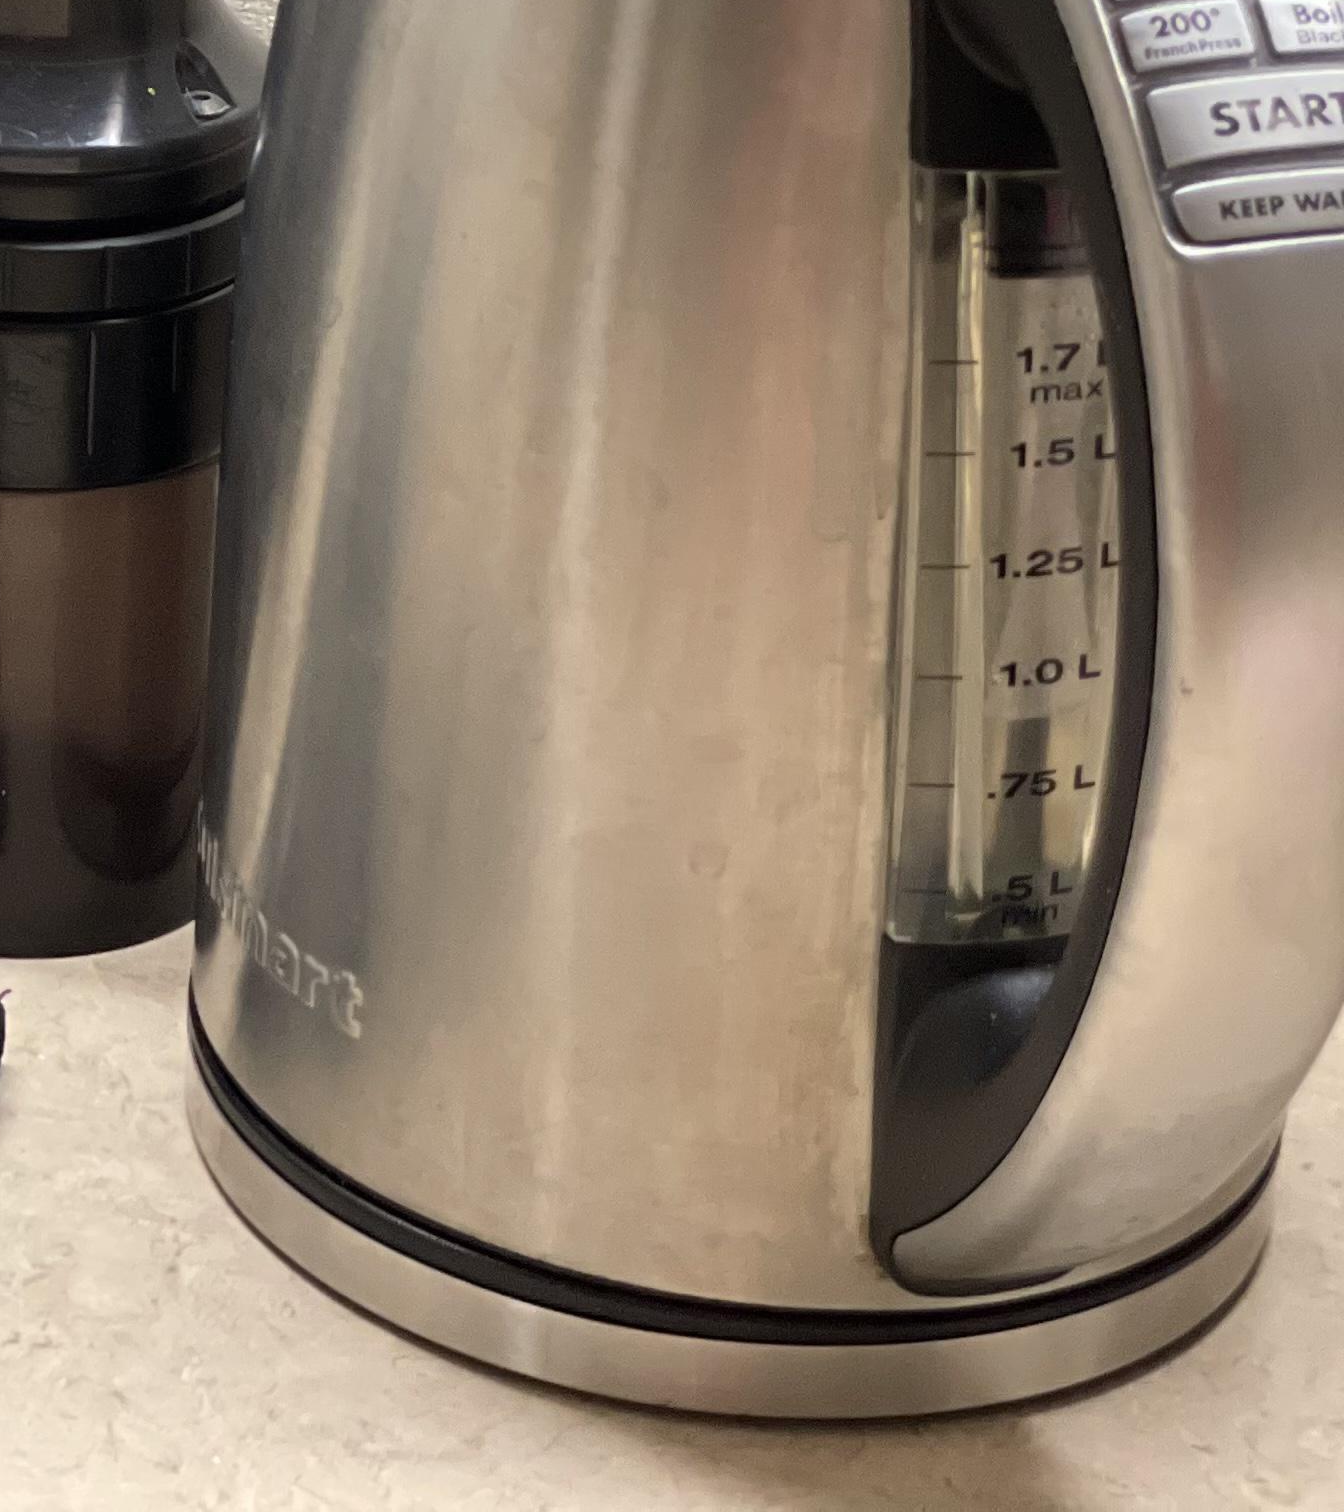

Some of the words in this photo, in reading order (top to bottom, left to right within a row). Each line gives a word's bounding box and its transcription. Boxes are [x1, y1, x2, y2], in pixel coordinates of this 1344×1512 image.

[1292, 0, 1344, 25] Boil
[1296, 29, 1344, 44] Blac
[1219, 196, 1285, 221] KEEP
[1293, 190, 1344, 213] WA
[1016, 343, 1081, 374] 1.7
[1029, 379, 1104, 404] max
[1010, 437, 1075, 469] 1.5
[1094, 434, 1116, 461] L
[989, 545, 1084, 580] 1.25
[1100, 541, 1120, 569] L
[999, 657, 1063, 688] 1.0
[1078, 653, 1102, 680] L
[987, 768, 1057, 800] .75
[1073, 764, 1096, 790] L
[1049, 871, 1073, 896] L
